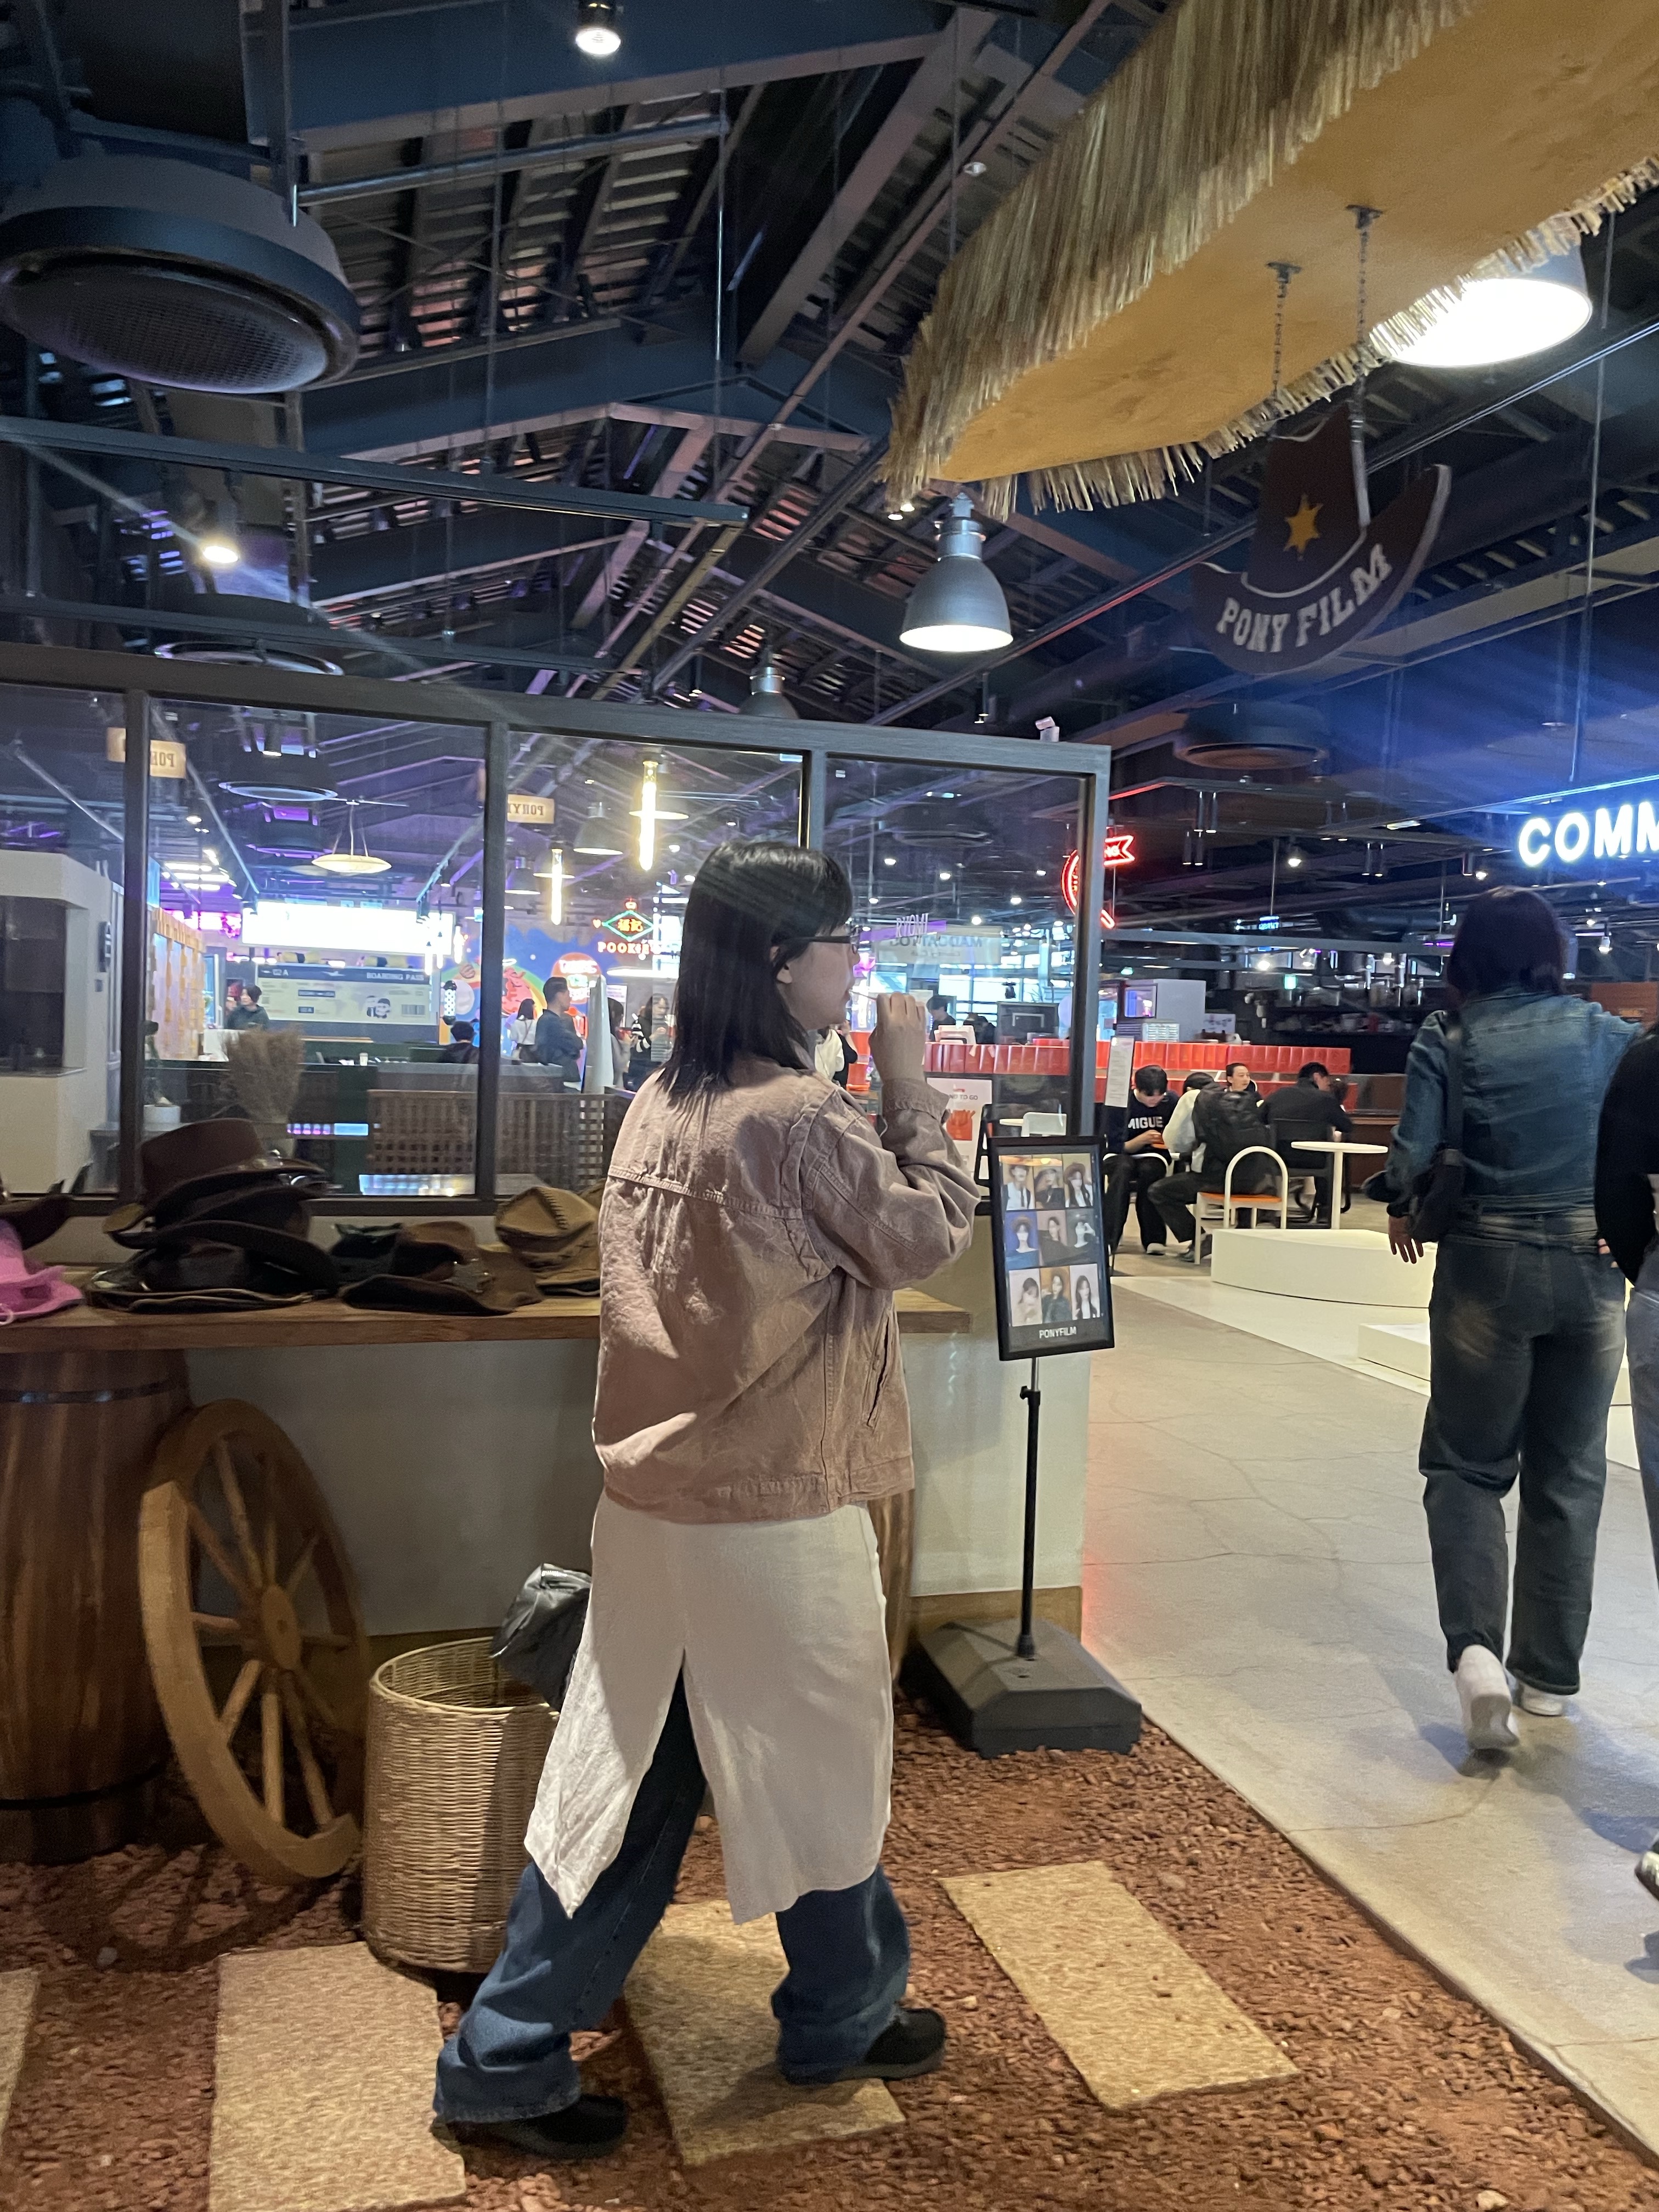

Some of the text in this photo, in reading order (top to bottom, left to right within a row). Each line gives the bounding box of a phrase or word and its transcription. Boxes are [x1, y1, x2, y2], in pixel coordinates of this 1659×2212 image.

[1216, 543, 1392, 652] PONY FILM
[366, 972, 403, 980] BOARDING
[1039, 1327, 1076, 1339] PONYFILM
